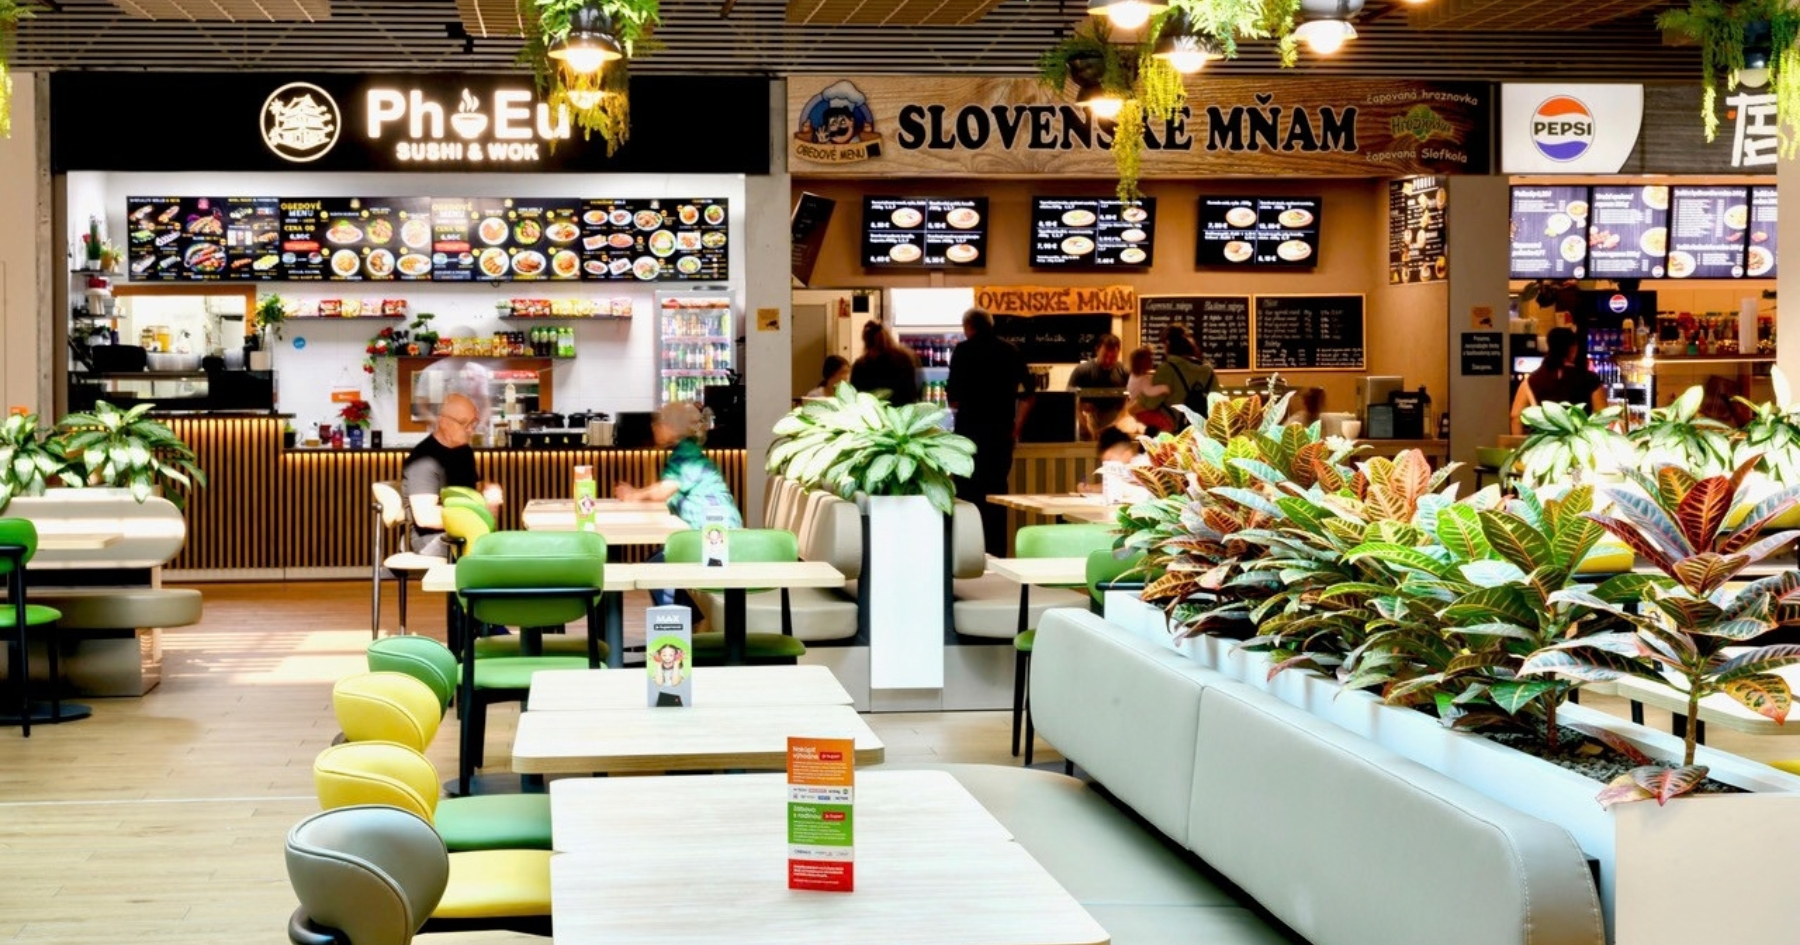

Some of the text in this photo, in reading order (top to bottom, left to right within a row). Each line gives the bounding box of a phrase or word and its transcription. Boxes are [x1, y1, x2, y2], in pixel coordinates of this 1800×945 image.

[1421, 88, 1479, 106] hroznovka
[1205, 92, 1359, 153] MŇAM
[1533, 121, 1592, 136] PEPSI
[396, 141, 540, 161] SUSHI & WOK
[796, 143, 865, 161] OBEDOVÉ MENU
[1421, 147, 1468, 164] Slofkola
[979, 288, 1134, 312] OVENSKÉ MŇAM
[656, 615, 680, 623] MAX
